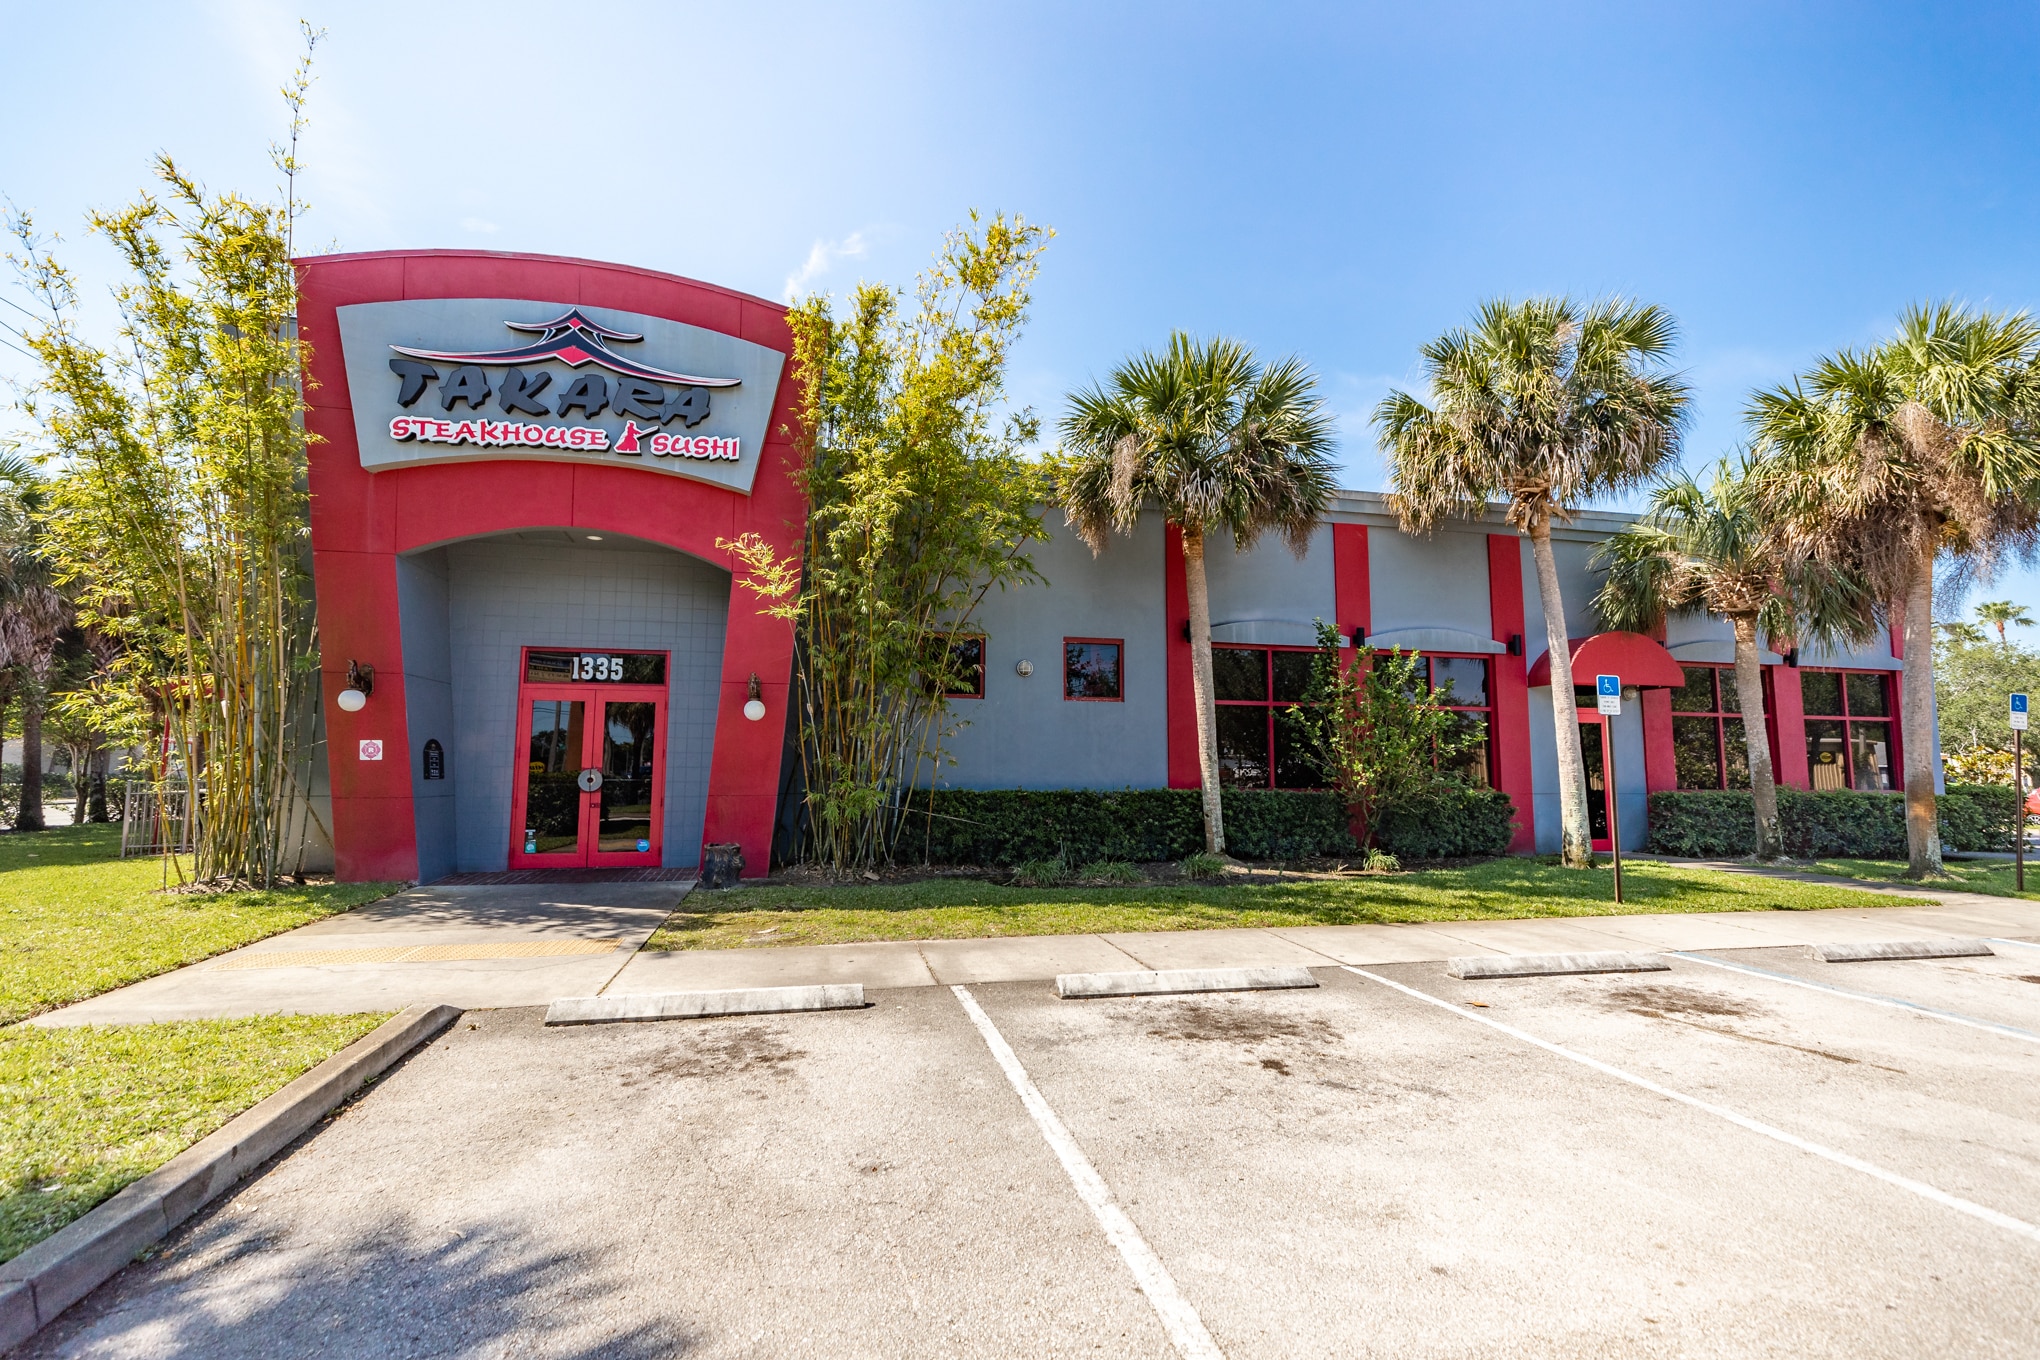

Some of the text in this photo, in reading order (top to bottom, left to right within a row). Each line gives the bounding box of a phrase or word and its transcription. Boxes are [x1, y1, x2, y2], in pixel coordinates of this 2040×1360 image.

[389, 358, 711, 428] TAKARA
[390, 417, 741, 461] STEAKHOUSE SUSHI
[572, 656, 624, 681] 1335
